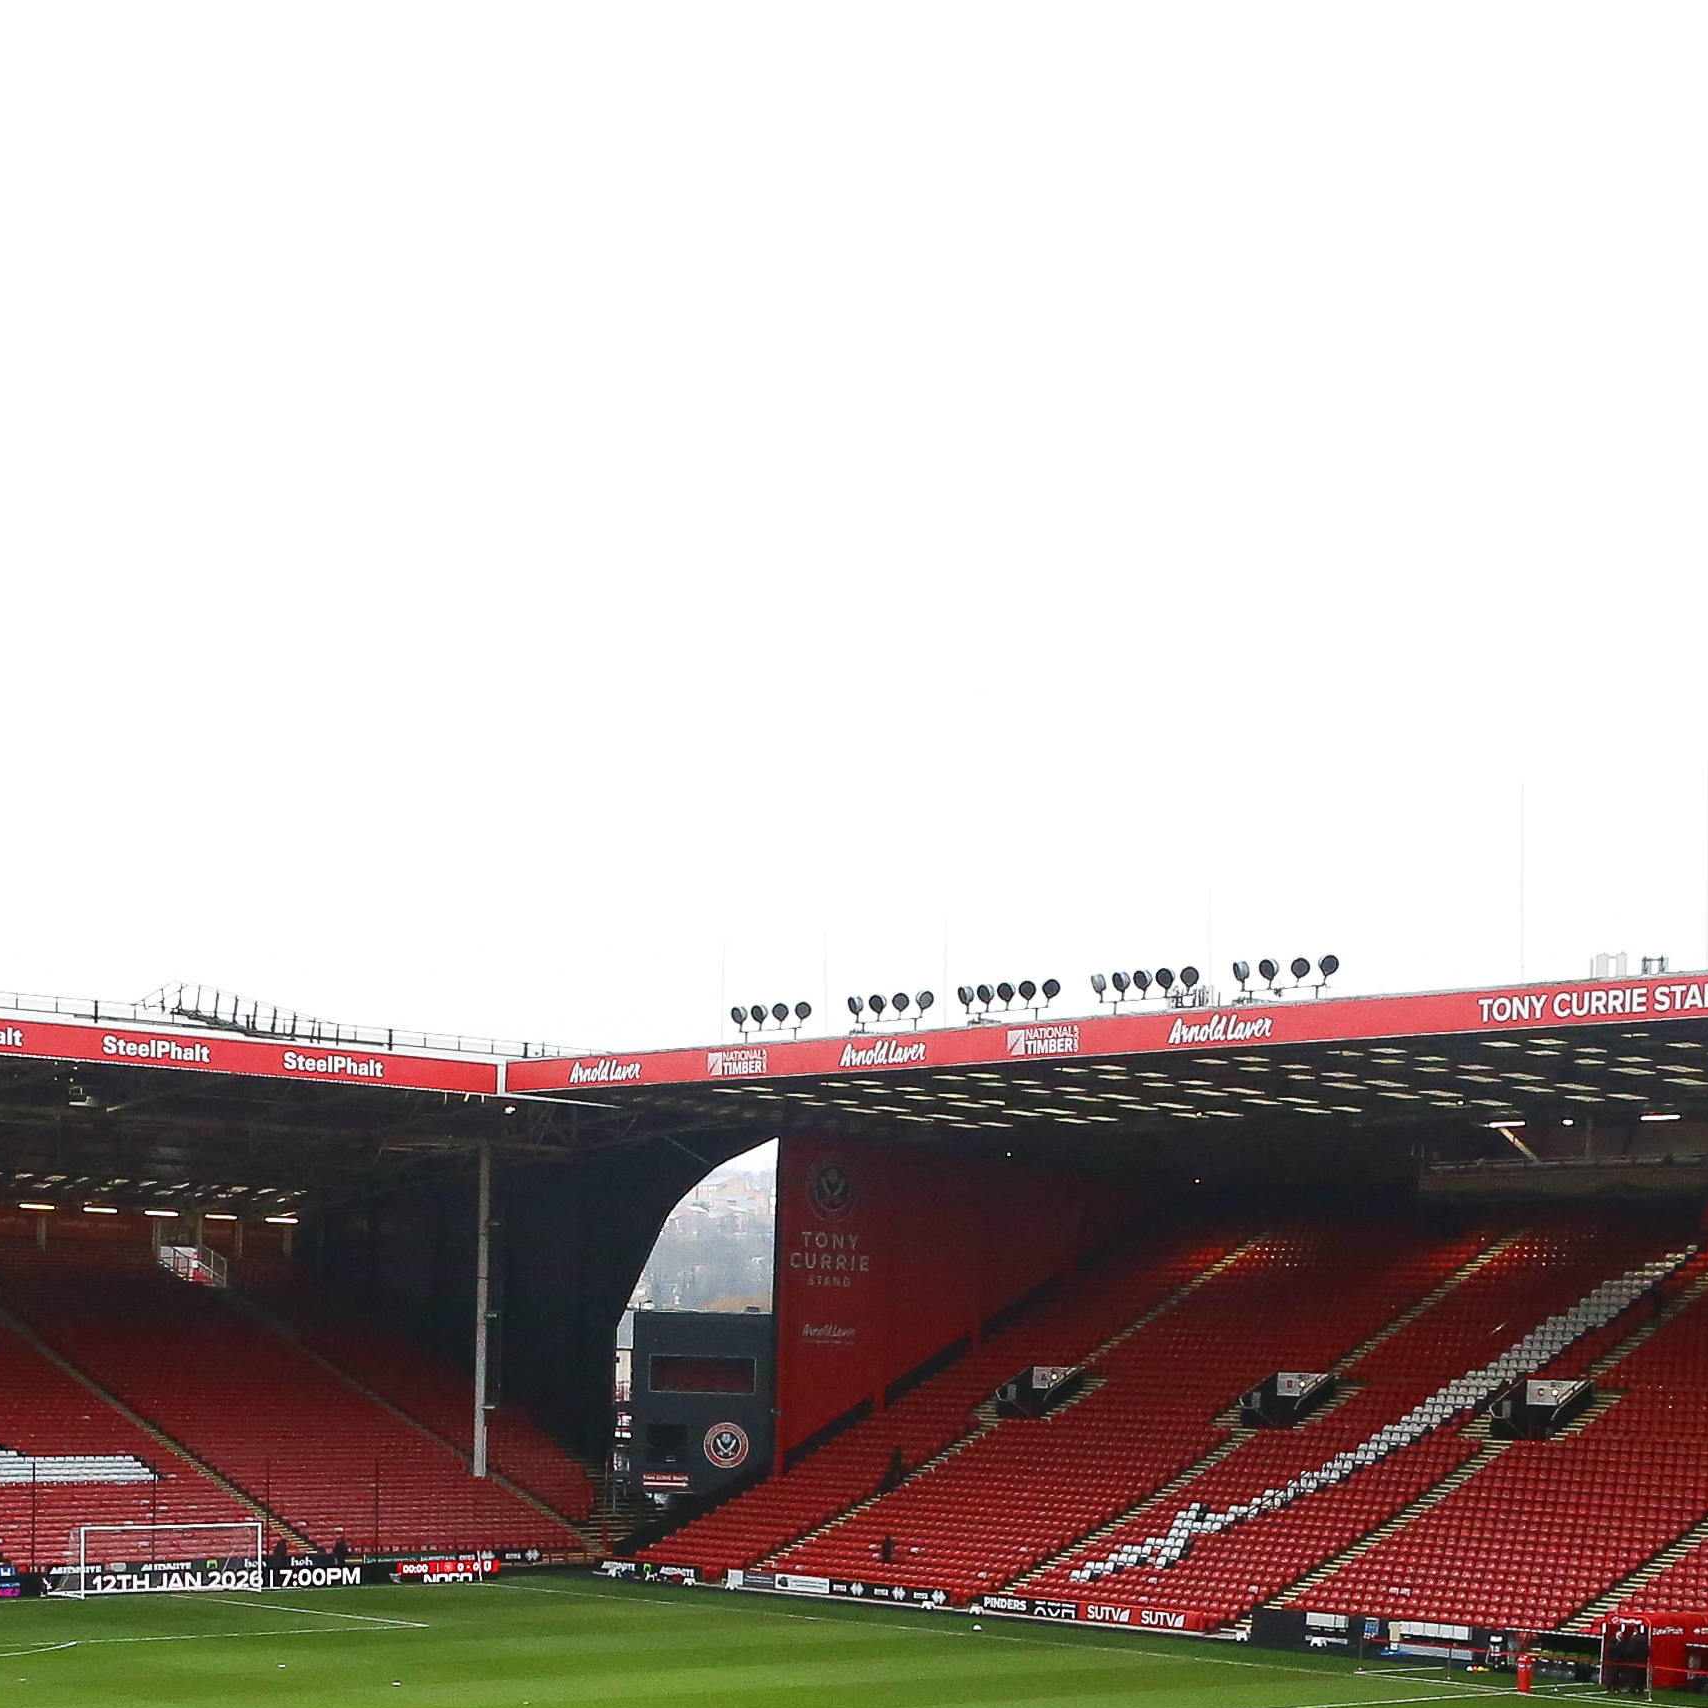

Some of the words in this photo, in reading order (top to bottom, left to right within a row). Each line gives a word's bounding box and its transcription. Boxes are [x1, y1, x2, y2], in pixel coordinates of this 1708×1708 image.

[1477, 994, 1548, 1023] TONY
[1552, 986, 1648, 1018] CURRIE
[1025, 1026, 1074, 1041] NATIONAL
[1168, 1014, 1227, 1045] Arnold
[1227, 1014, 1273, 1041] Laver
[101, 1035, 211, 1064] SteelPhalt
[722, 1050, 763, 1062] NATIONAL
[840, 1040, 887, 1067] Arnold
[887, 1042, 927, 1064] Laver
[1025, 1038, 1073, 1055] TIMBER
[282, 1051, 384, 1078] SteelPhalt
[569, 1060, 610, 1083] Arnold
[610, 1060, 642, 1081] Laver
[722, 1061, 763, 1076] TIMBER
[802, 1231, 861, 1250] TONY
[790, 1252, 870, 1273] CURRIE
[807, 1275, 851, 1288] STAND
[92, 1573, 150, 1592] 12TH
[157, 1571, 202, 1590] JAN
[279, 1567, 361, 1587] 7:00PM
[984, 1596, 1027, 1611] PINDERS
[1087, 1605, 1122, 1621] SUTV
[1141, 1610, 1177, 1627] SUTV
